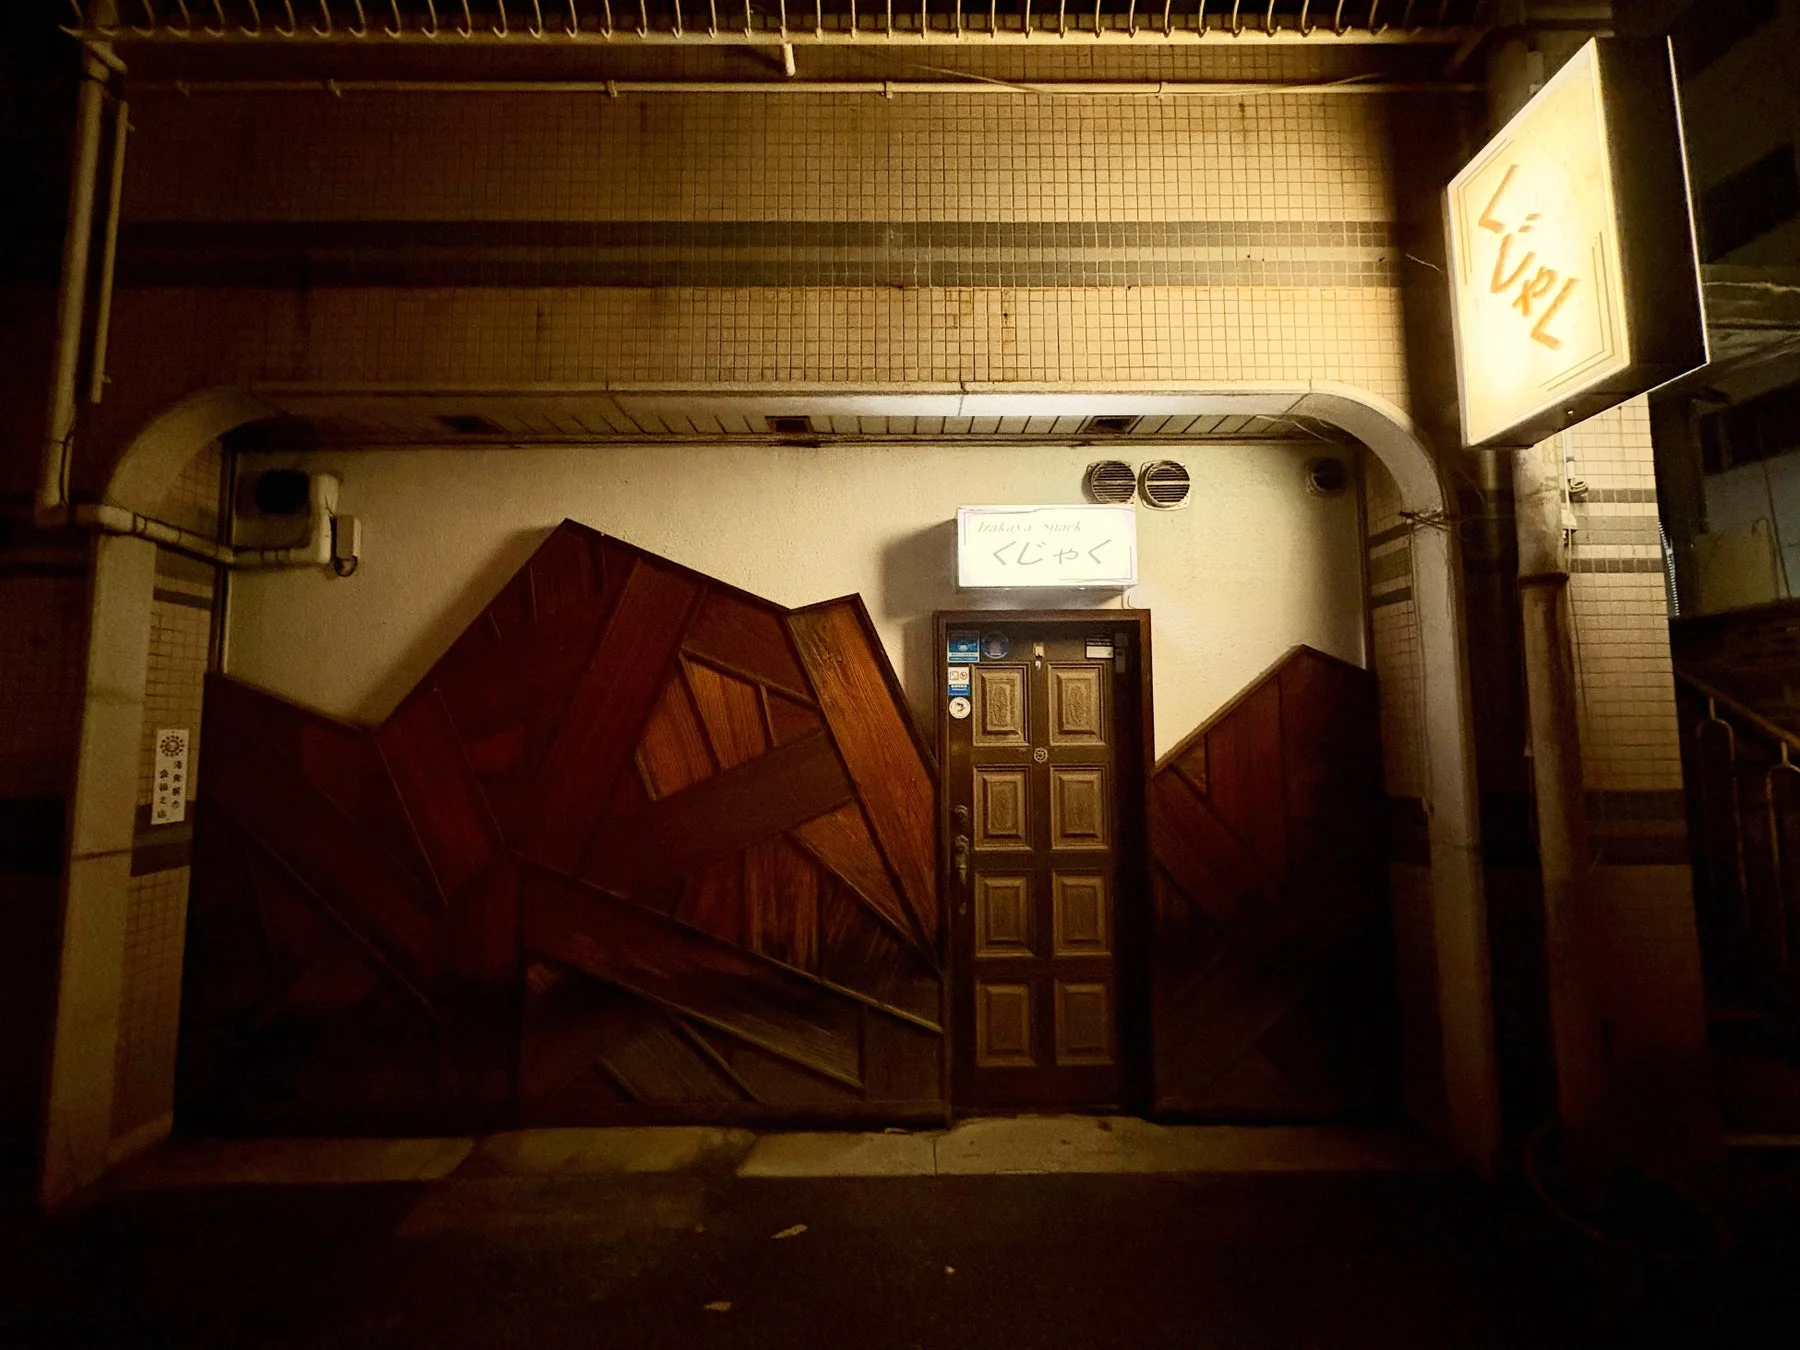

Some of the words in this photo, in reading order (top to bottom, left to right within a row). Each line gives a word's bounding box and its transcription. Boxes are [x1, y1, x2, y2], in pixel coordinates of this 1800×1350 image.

[1478, 164, 1582, 351] くじゃく
[992, 539, 1112, 566] くじゃく
